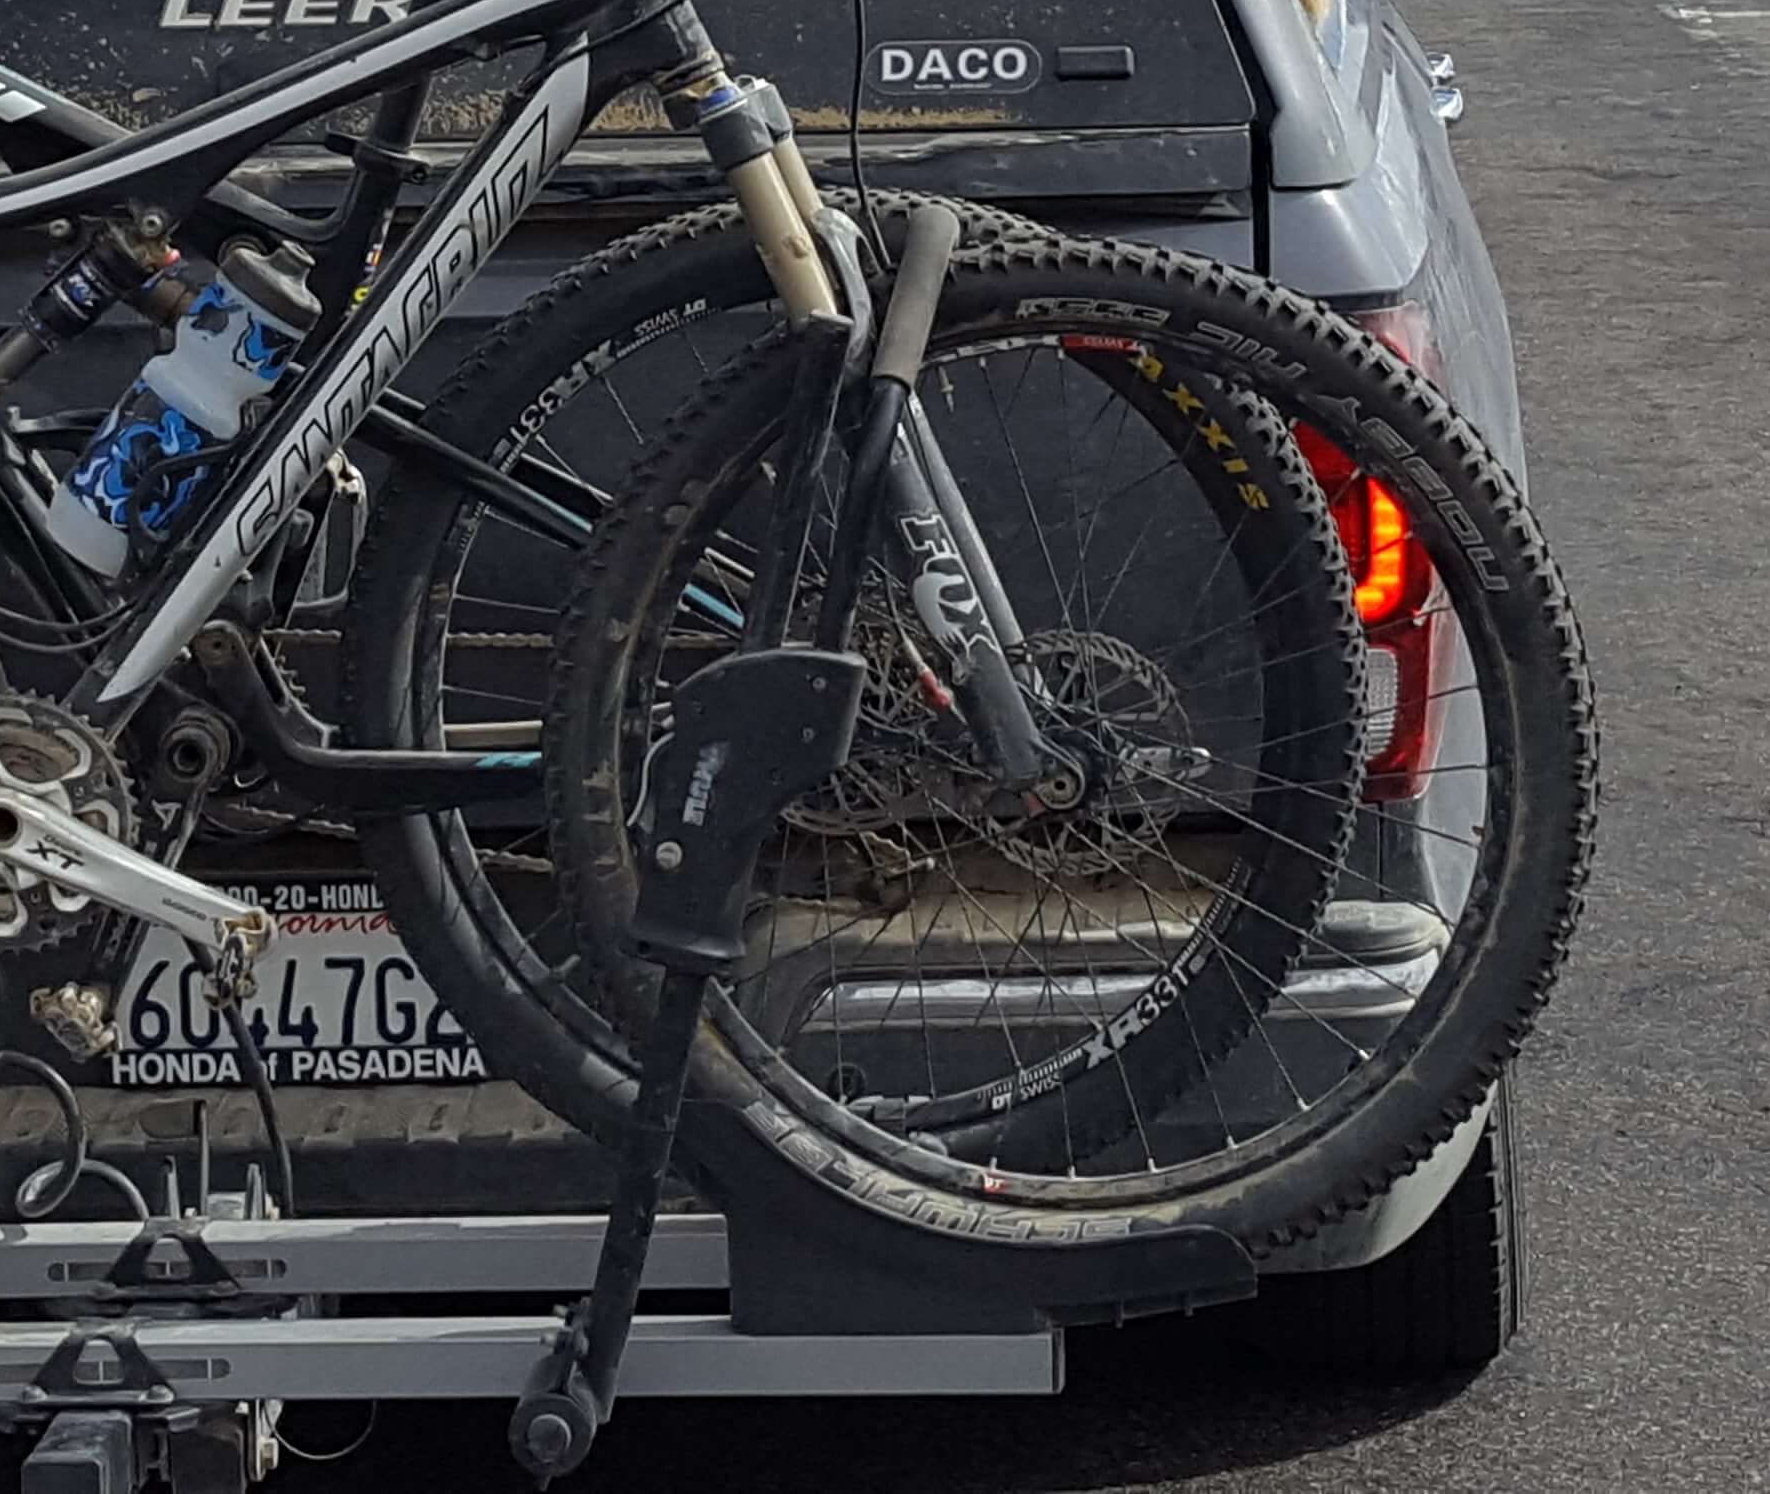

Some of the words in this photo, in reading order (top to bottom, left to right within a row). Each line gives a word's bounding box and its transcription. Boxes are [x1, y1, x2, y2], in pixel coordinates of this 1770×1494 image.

[881, 47, 1027, 80] DACO
[634, 309, 678, 336] SWISS
[683, 298, 706, 316] DT
[509, 339, 617, 444] XR331
[1134, 353, 1270, 510] AXXIS
[26, 839, 85, 870] XT
[1082, 959, 1190, 1070] XR331
[112, 1053, 241, 1084] HONDA
[292, 1048, 486, 1081] PASADENA
